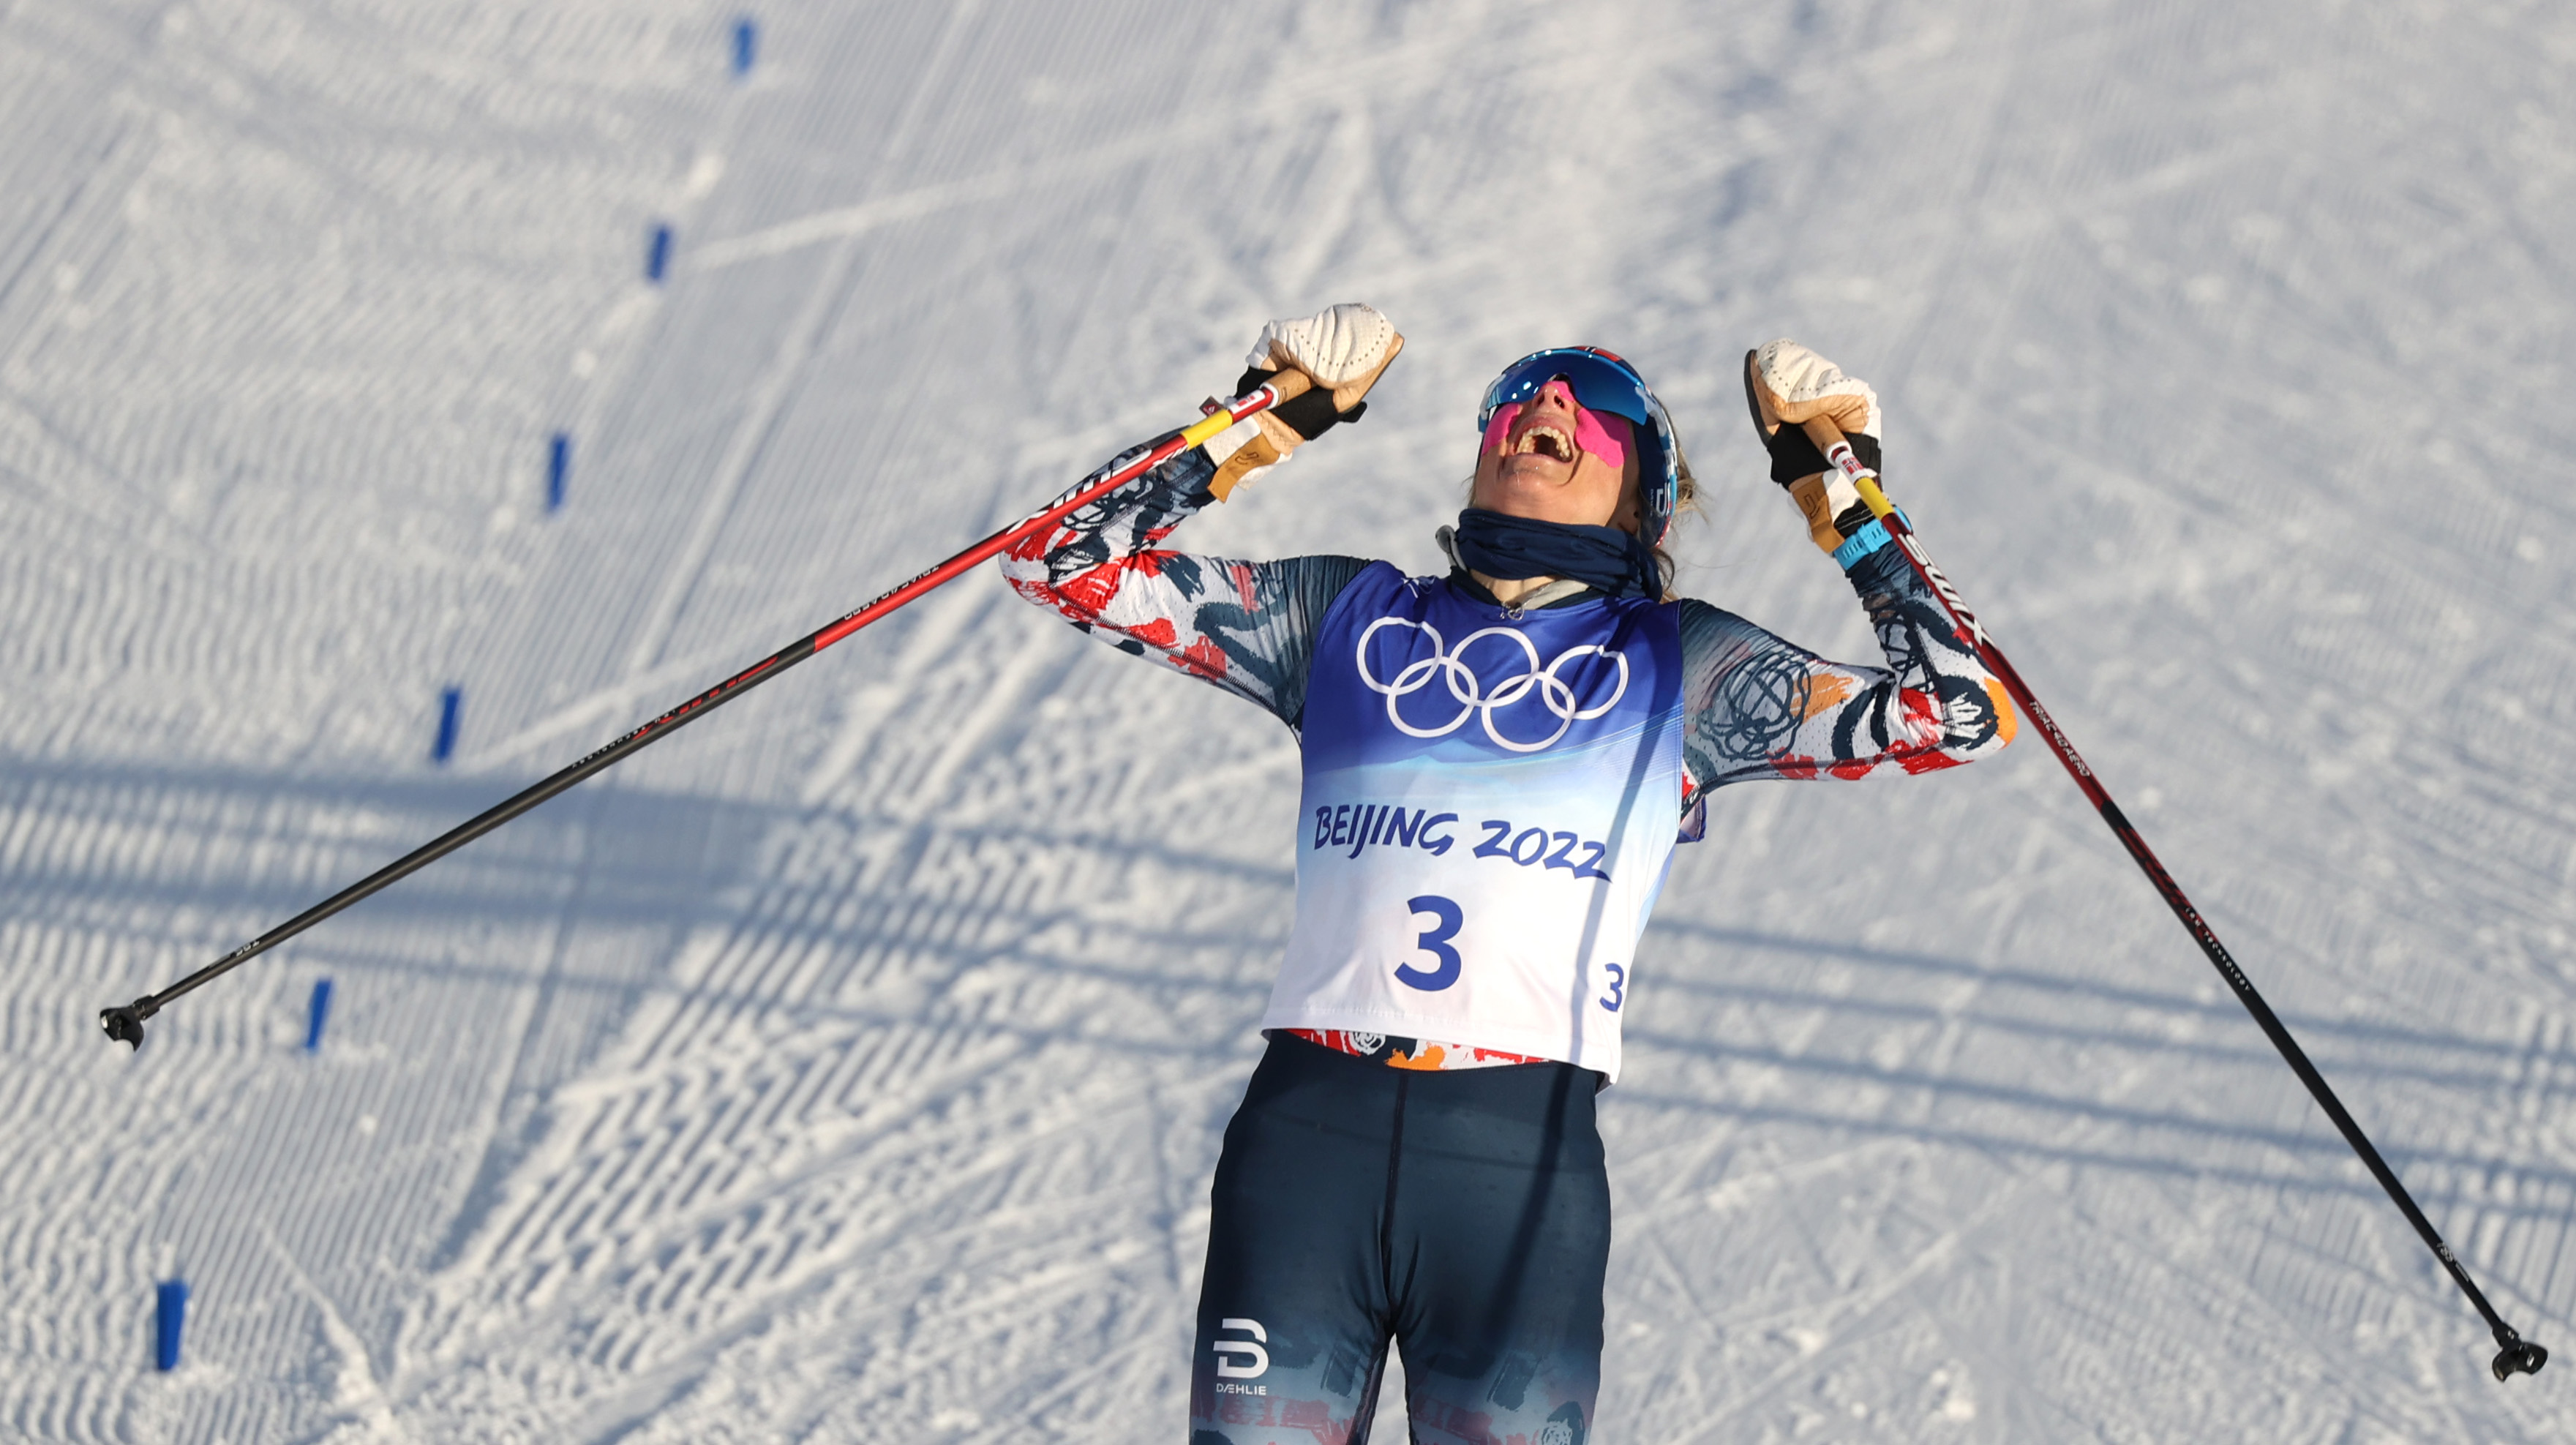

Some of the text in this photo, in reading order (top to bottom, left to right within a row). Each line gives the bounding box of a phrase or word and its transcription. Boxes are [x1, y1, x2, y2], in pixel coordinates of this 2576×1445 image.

[1898, 533, 1996, 647] SWIX
[1314, 803, 1612, 882] BEIJING 2022
[1394, 895, 1464, 991] 3
[1599, 962, 1625, 1013] 3
[1216, 1383, 1267, 1396] DÆHLIE
